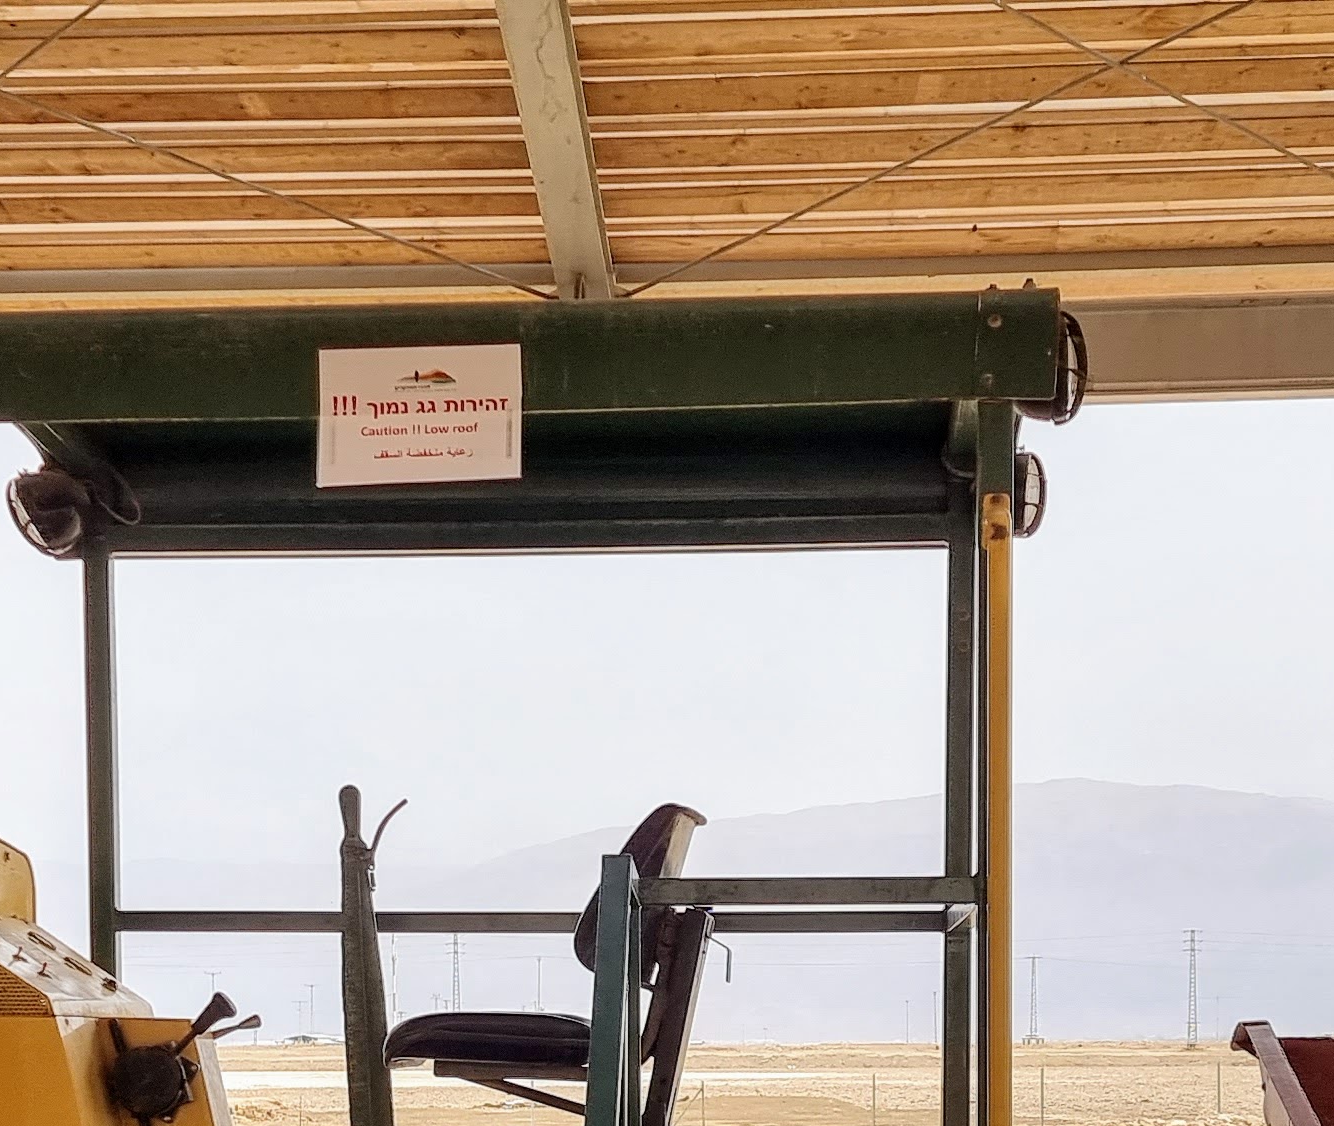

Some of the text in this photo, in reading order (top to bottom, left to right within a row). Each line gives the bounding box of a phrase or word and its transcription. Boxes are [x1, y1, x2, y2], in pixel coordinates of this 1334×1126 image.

[333, 395, 509, 419] זהירות גג נמוך !!!
[361, 426, 408, 437] Caution
[425, 423, 450, 434] Low
[452, 422, 479, 434] roof
